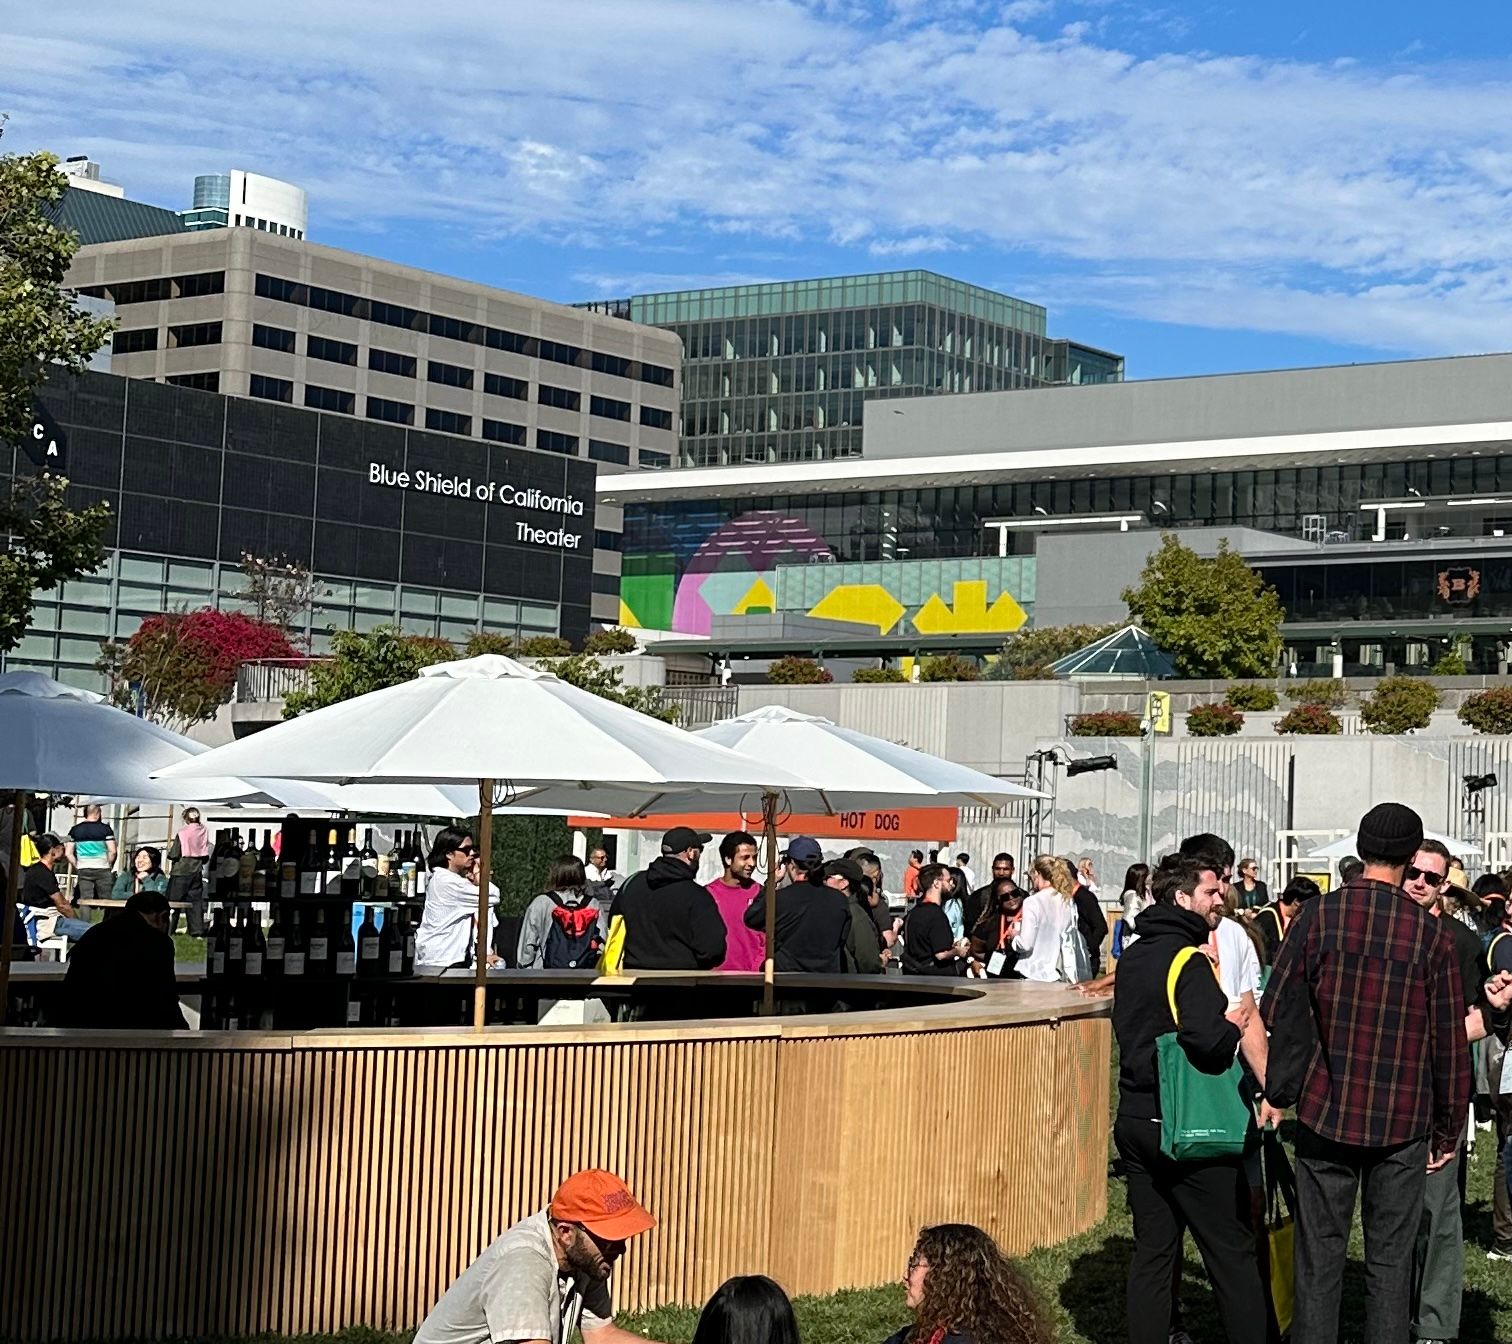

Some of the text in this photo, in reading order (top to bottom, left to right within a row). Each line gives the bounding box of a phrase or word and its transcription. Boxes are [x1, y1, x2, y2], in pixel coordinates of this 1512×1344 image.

[369, 462, 584, 516] Blue Shield of California
[516, 521, 582, 549] Theater
[841, 812, 900, 831] HOT DOG
